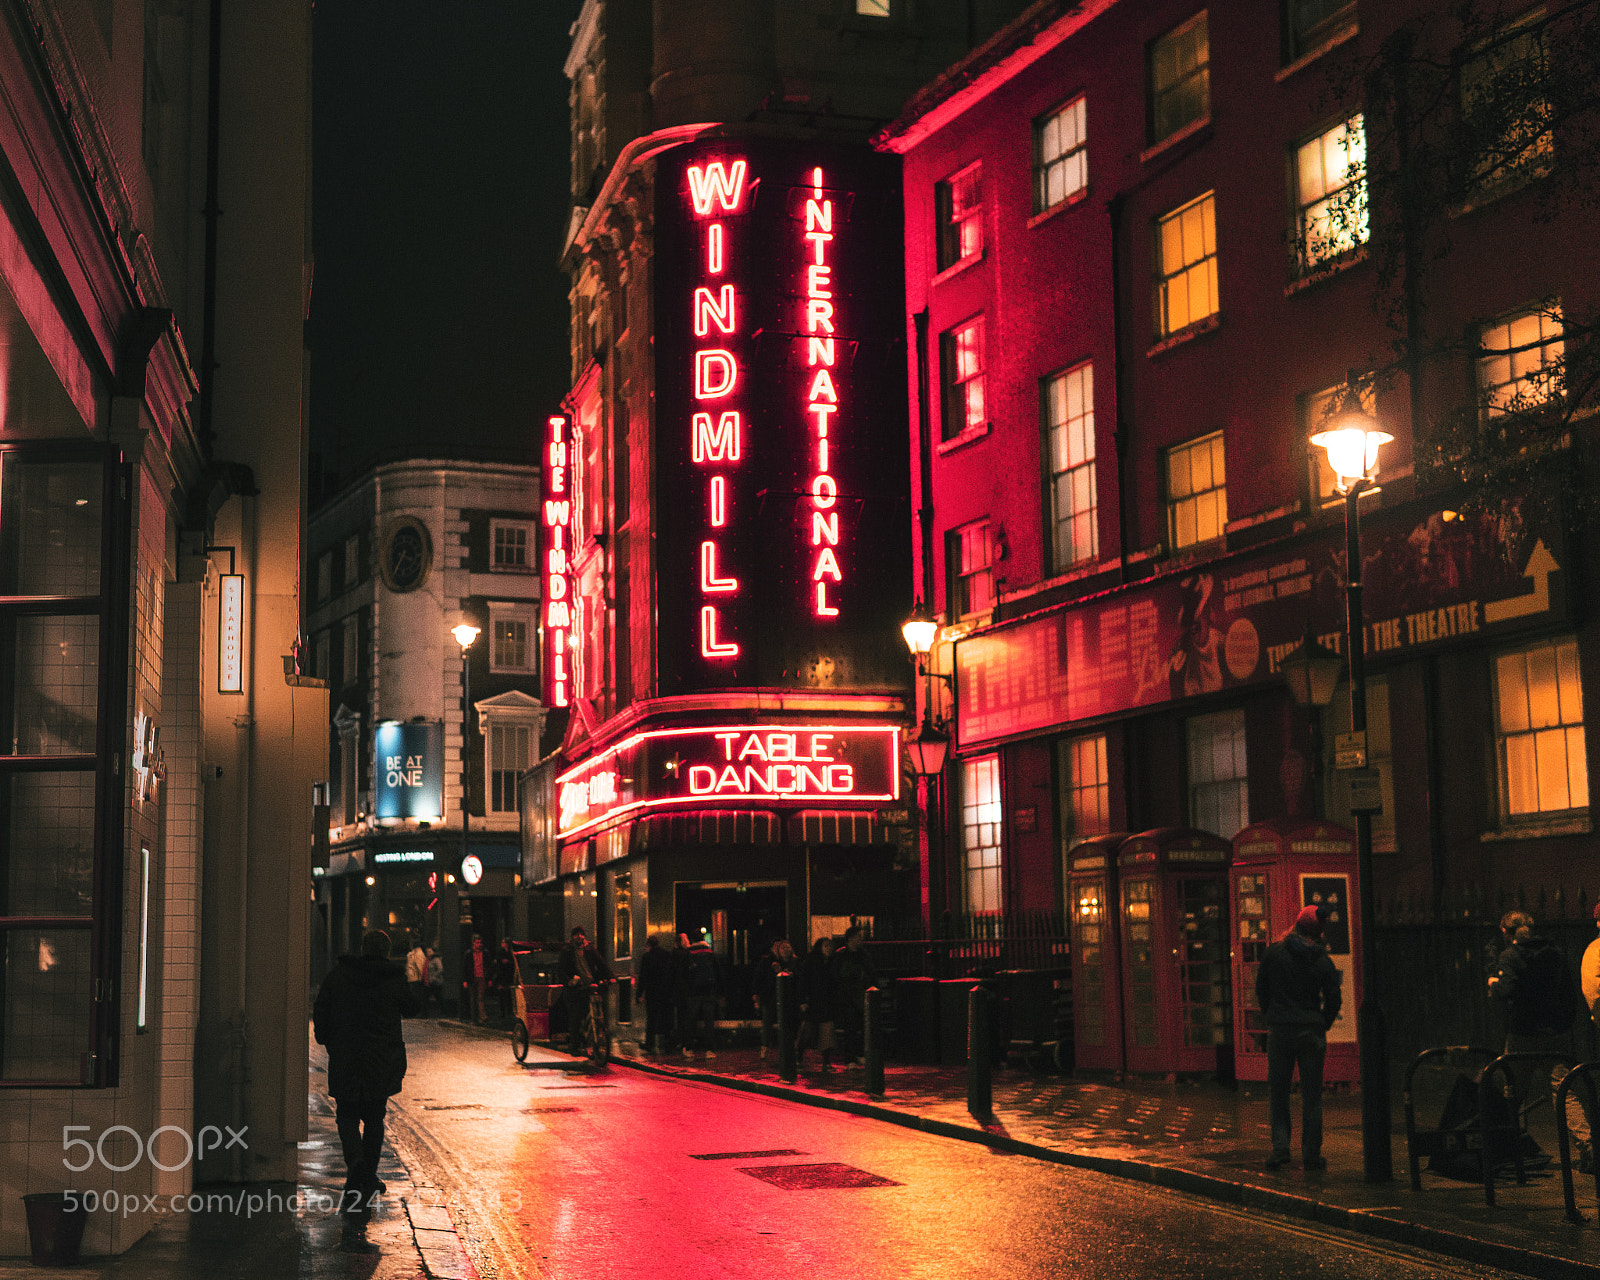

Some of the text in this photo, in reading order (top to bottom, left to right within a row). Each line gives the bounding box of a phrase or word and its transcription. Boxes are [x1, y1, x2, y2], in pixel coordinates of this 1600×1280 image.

[686, 159, 747, 659] WINDMILL
[804, 166, 842, 617] INTERNATIONAL
[545, 417, 570, 707] THE WINDMILL
[1372, 618, 1402, 651] THE
[1406, 600, 1480, 646] THEATRE
[962, 600, 1160, 713] THRILLER
[386, 754, 423, 771] BE AT
[715, 732, 835, 762] TABLE
[386, 770, 424, 788] ONE
[689, 764, 854, 794] DANCING
